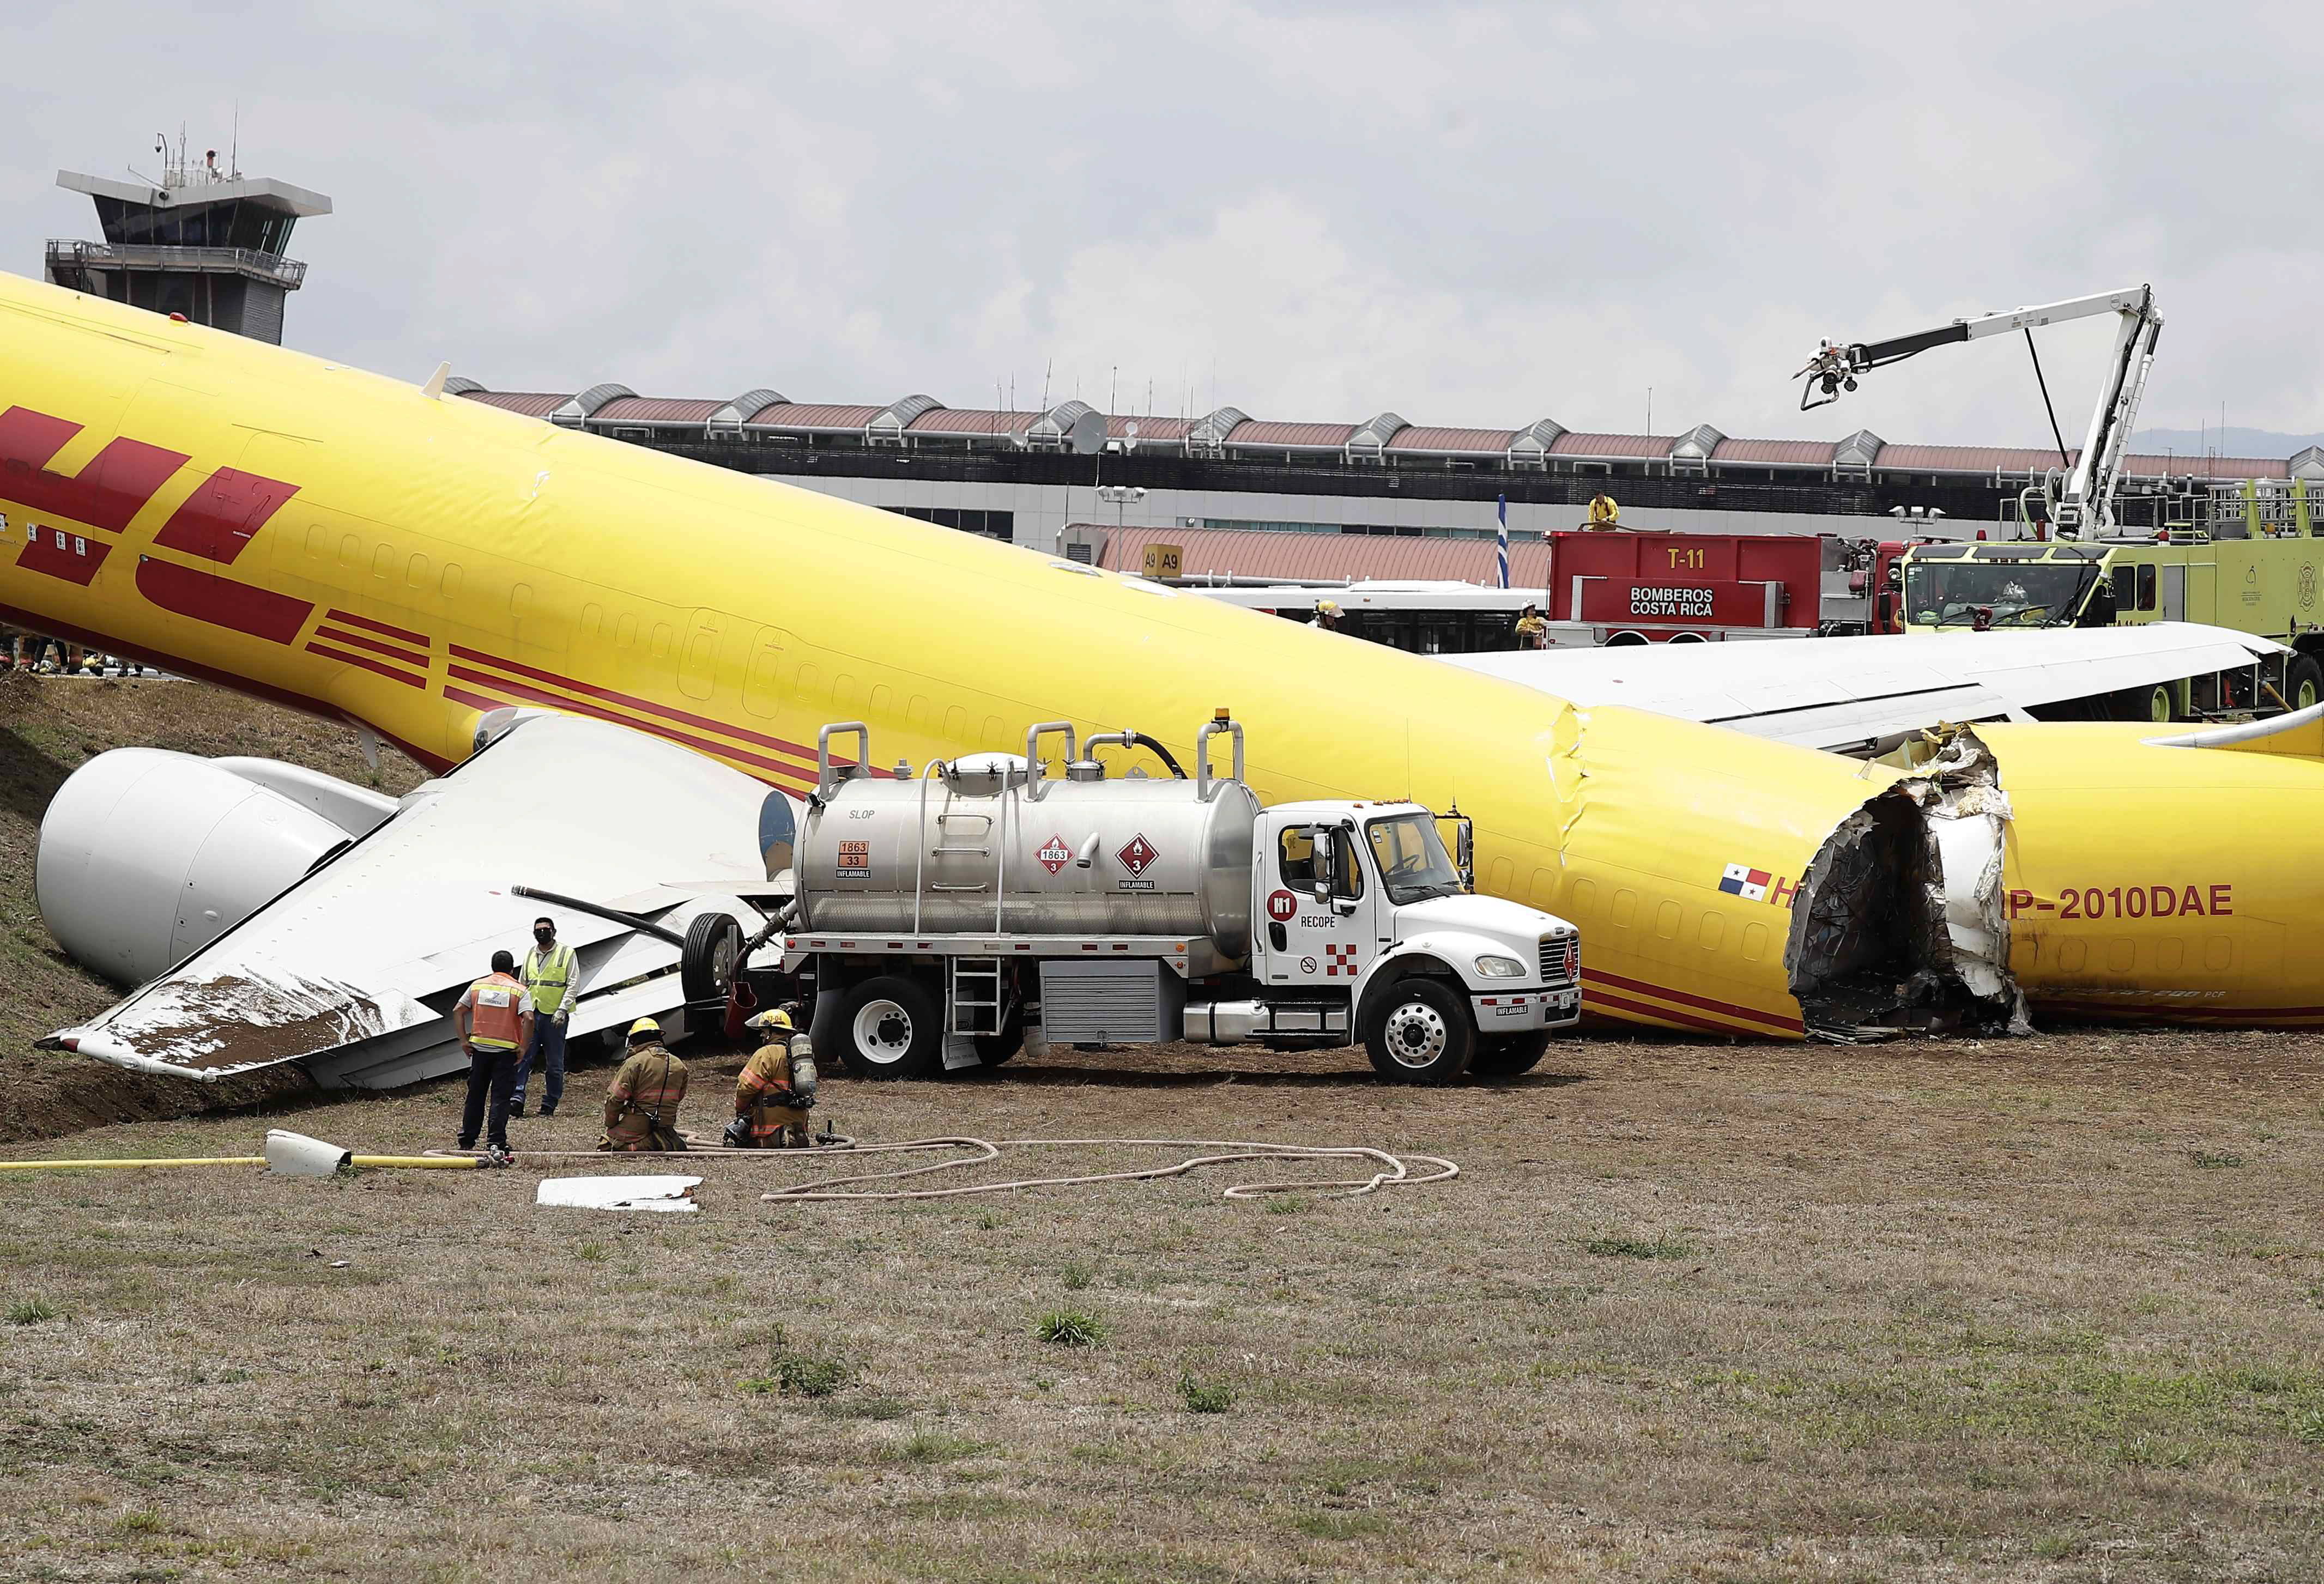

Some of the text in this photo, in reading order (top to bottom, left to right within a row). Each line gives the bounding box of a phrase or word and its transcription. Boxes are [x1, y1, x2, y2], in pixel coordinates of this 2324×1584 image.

[0, 405, 316, 646] HL
[1145, 552, 1155, 568] A9
[1161, 553, 1178, 569] A9
[1667, 548, 1704, 569] T-11
[1630, 587, 1714, 603] BOMBEROS
[1630, 601, 1713, 616] COSTA RICA
[849, 810, 875, 819] SLOP
[842, 842, 866, 852] 1863
[1042, 850, 1066, 859] 1863
[846, 856, 860, 865] 33
[1132, 860, 1141, 871] 3
[1050, 863, 1057, 871] 3
[1119, 881, 1154, 889] INFLAMABLE
[1274, 897, 1291, 913] H1
[2003, 885, 2233, 919] P-2010DAE
[1301, 916, 1335, 927] RECOPE
[1497, 1006, 1528, 1015] INFLAMABLE
